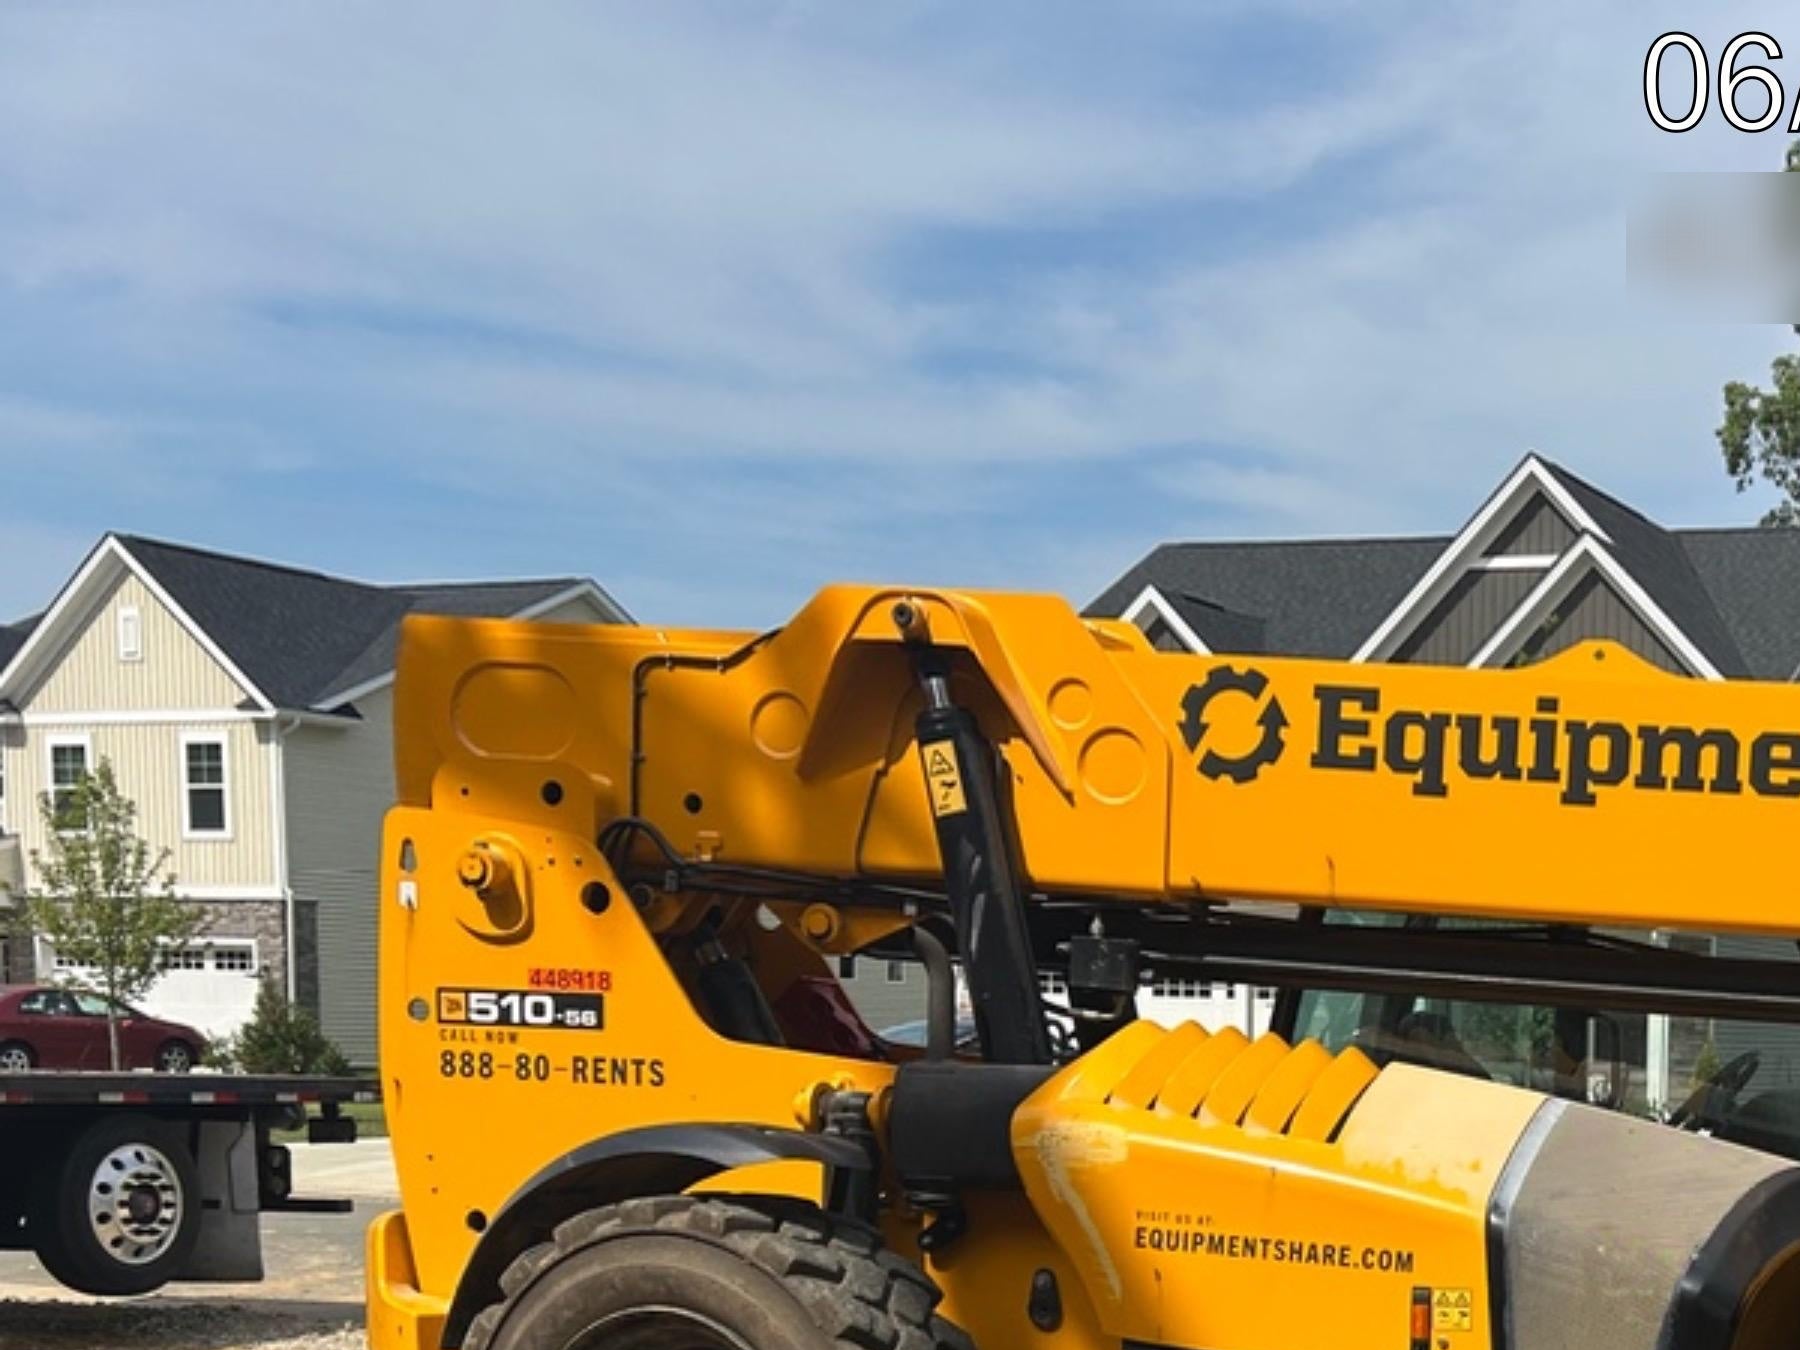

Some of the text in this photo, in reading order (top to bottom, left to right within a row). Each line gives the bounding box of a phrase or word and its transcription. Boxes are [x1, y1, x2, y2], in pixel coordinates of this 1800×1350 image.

[528, 968, 612, 991] 448918
[440, 1030, 519, 1045] CALL NOW
[440, 1050, 665, 1087] 888-80-RENTS
[1135, 1227, 1414, 1272] EQUIPMENTSHARE.COM
